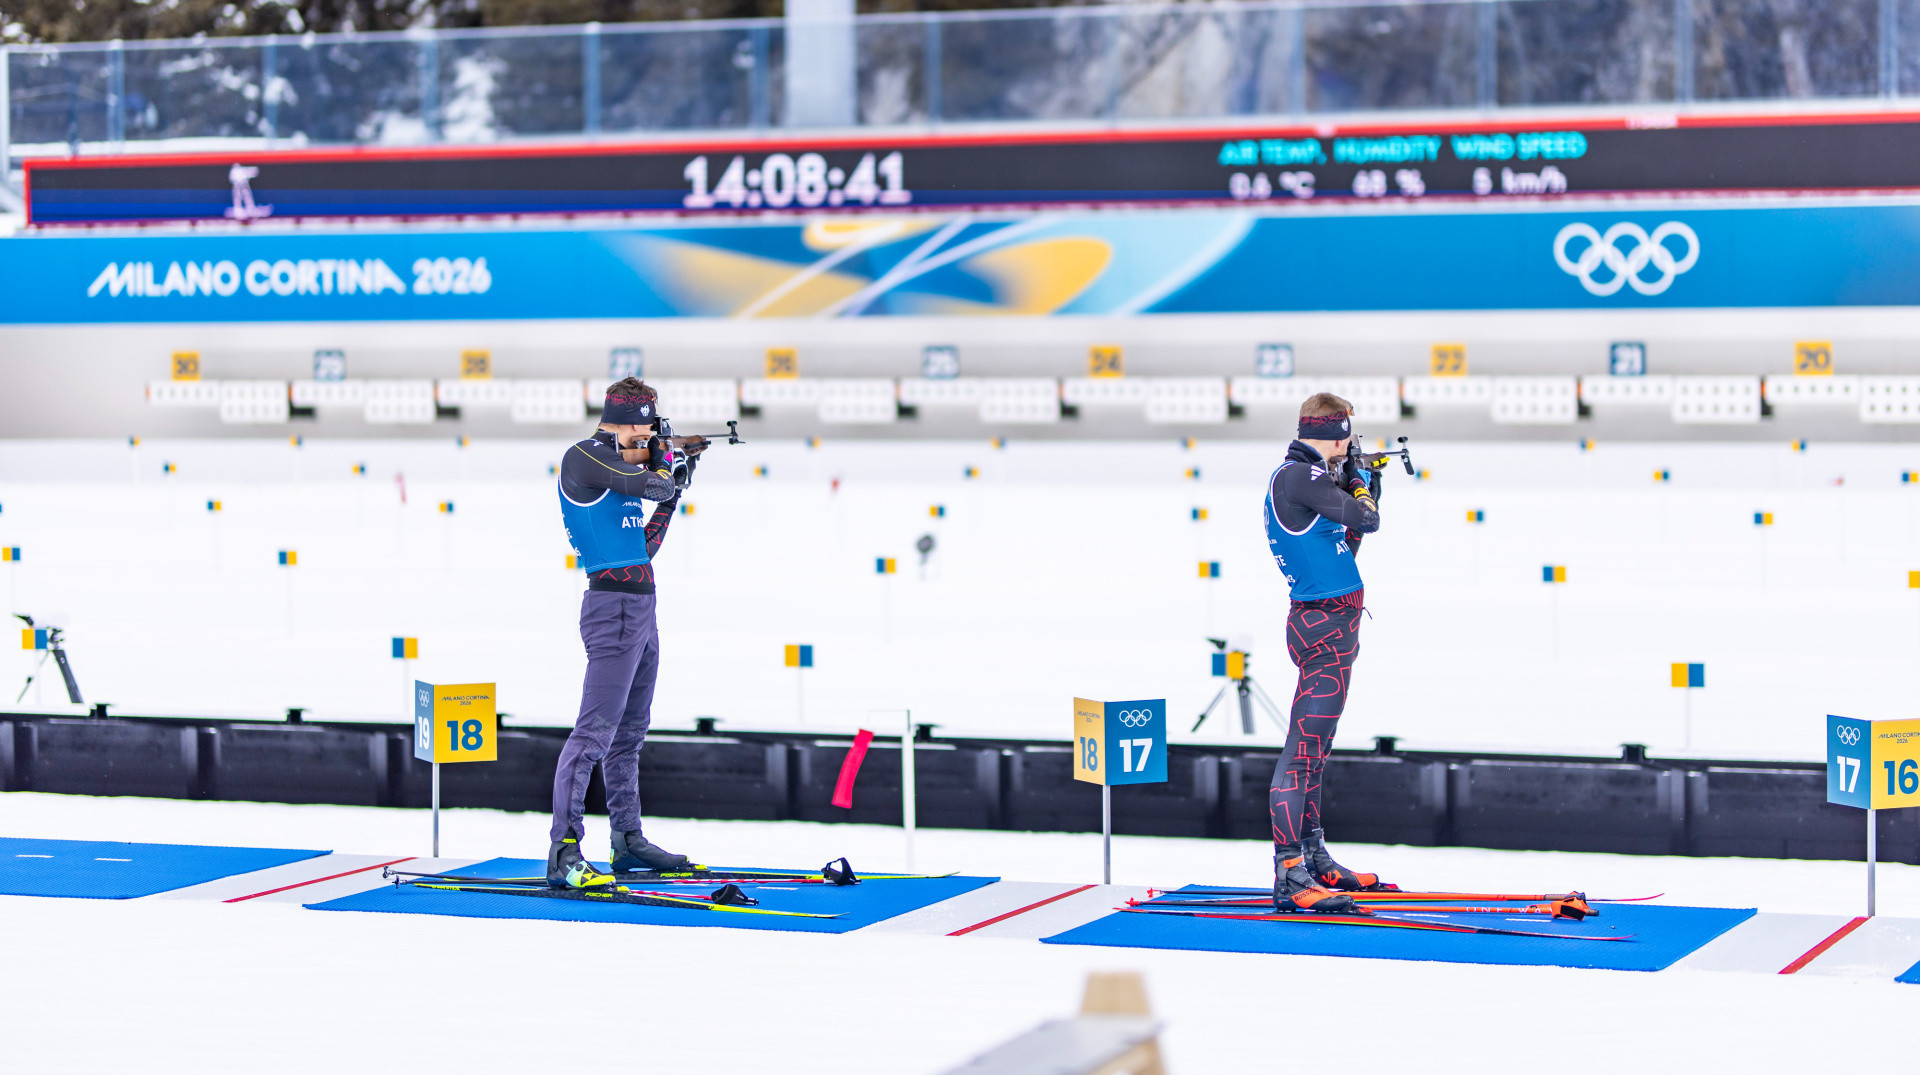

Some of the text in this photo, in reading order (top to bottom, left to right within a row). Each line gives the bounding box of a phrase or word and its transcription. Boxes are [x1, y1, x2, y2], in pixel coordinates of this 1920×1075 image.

[1218, 139, 1259, 165] AIR
[1333, 136, 1442, 164] HUMIDITY
[1451, 133, 1515, 161] WIND
[1516, 131, 1588, 160] SPEED
[683, 151, 913, 208] 14:08:41
[1395, 168, 1426, 197] %
[1501, 165, 1567, 194] km/h
[87, 256, 492, 298] MILANO CORTINA 2026
[1436, 348, 1464, 372] 22
[1614, 345, 1643, 375] 21
[1800, 346, 1830, 371] 20
[418, 716, 430, 750] 19
[446, 718, 484, 752] 18
[1080, 736, 1098, 772] 18
[1119, 737, 1153, 773] 17
[1836, 755, 1861, 794] 17
[1883, 758, 1920, 796] 16
